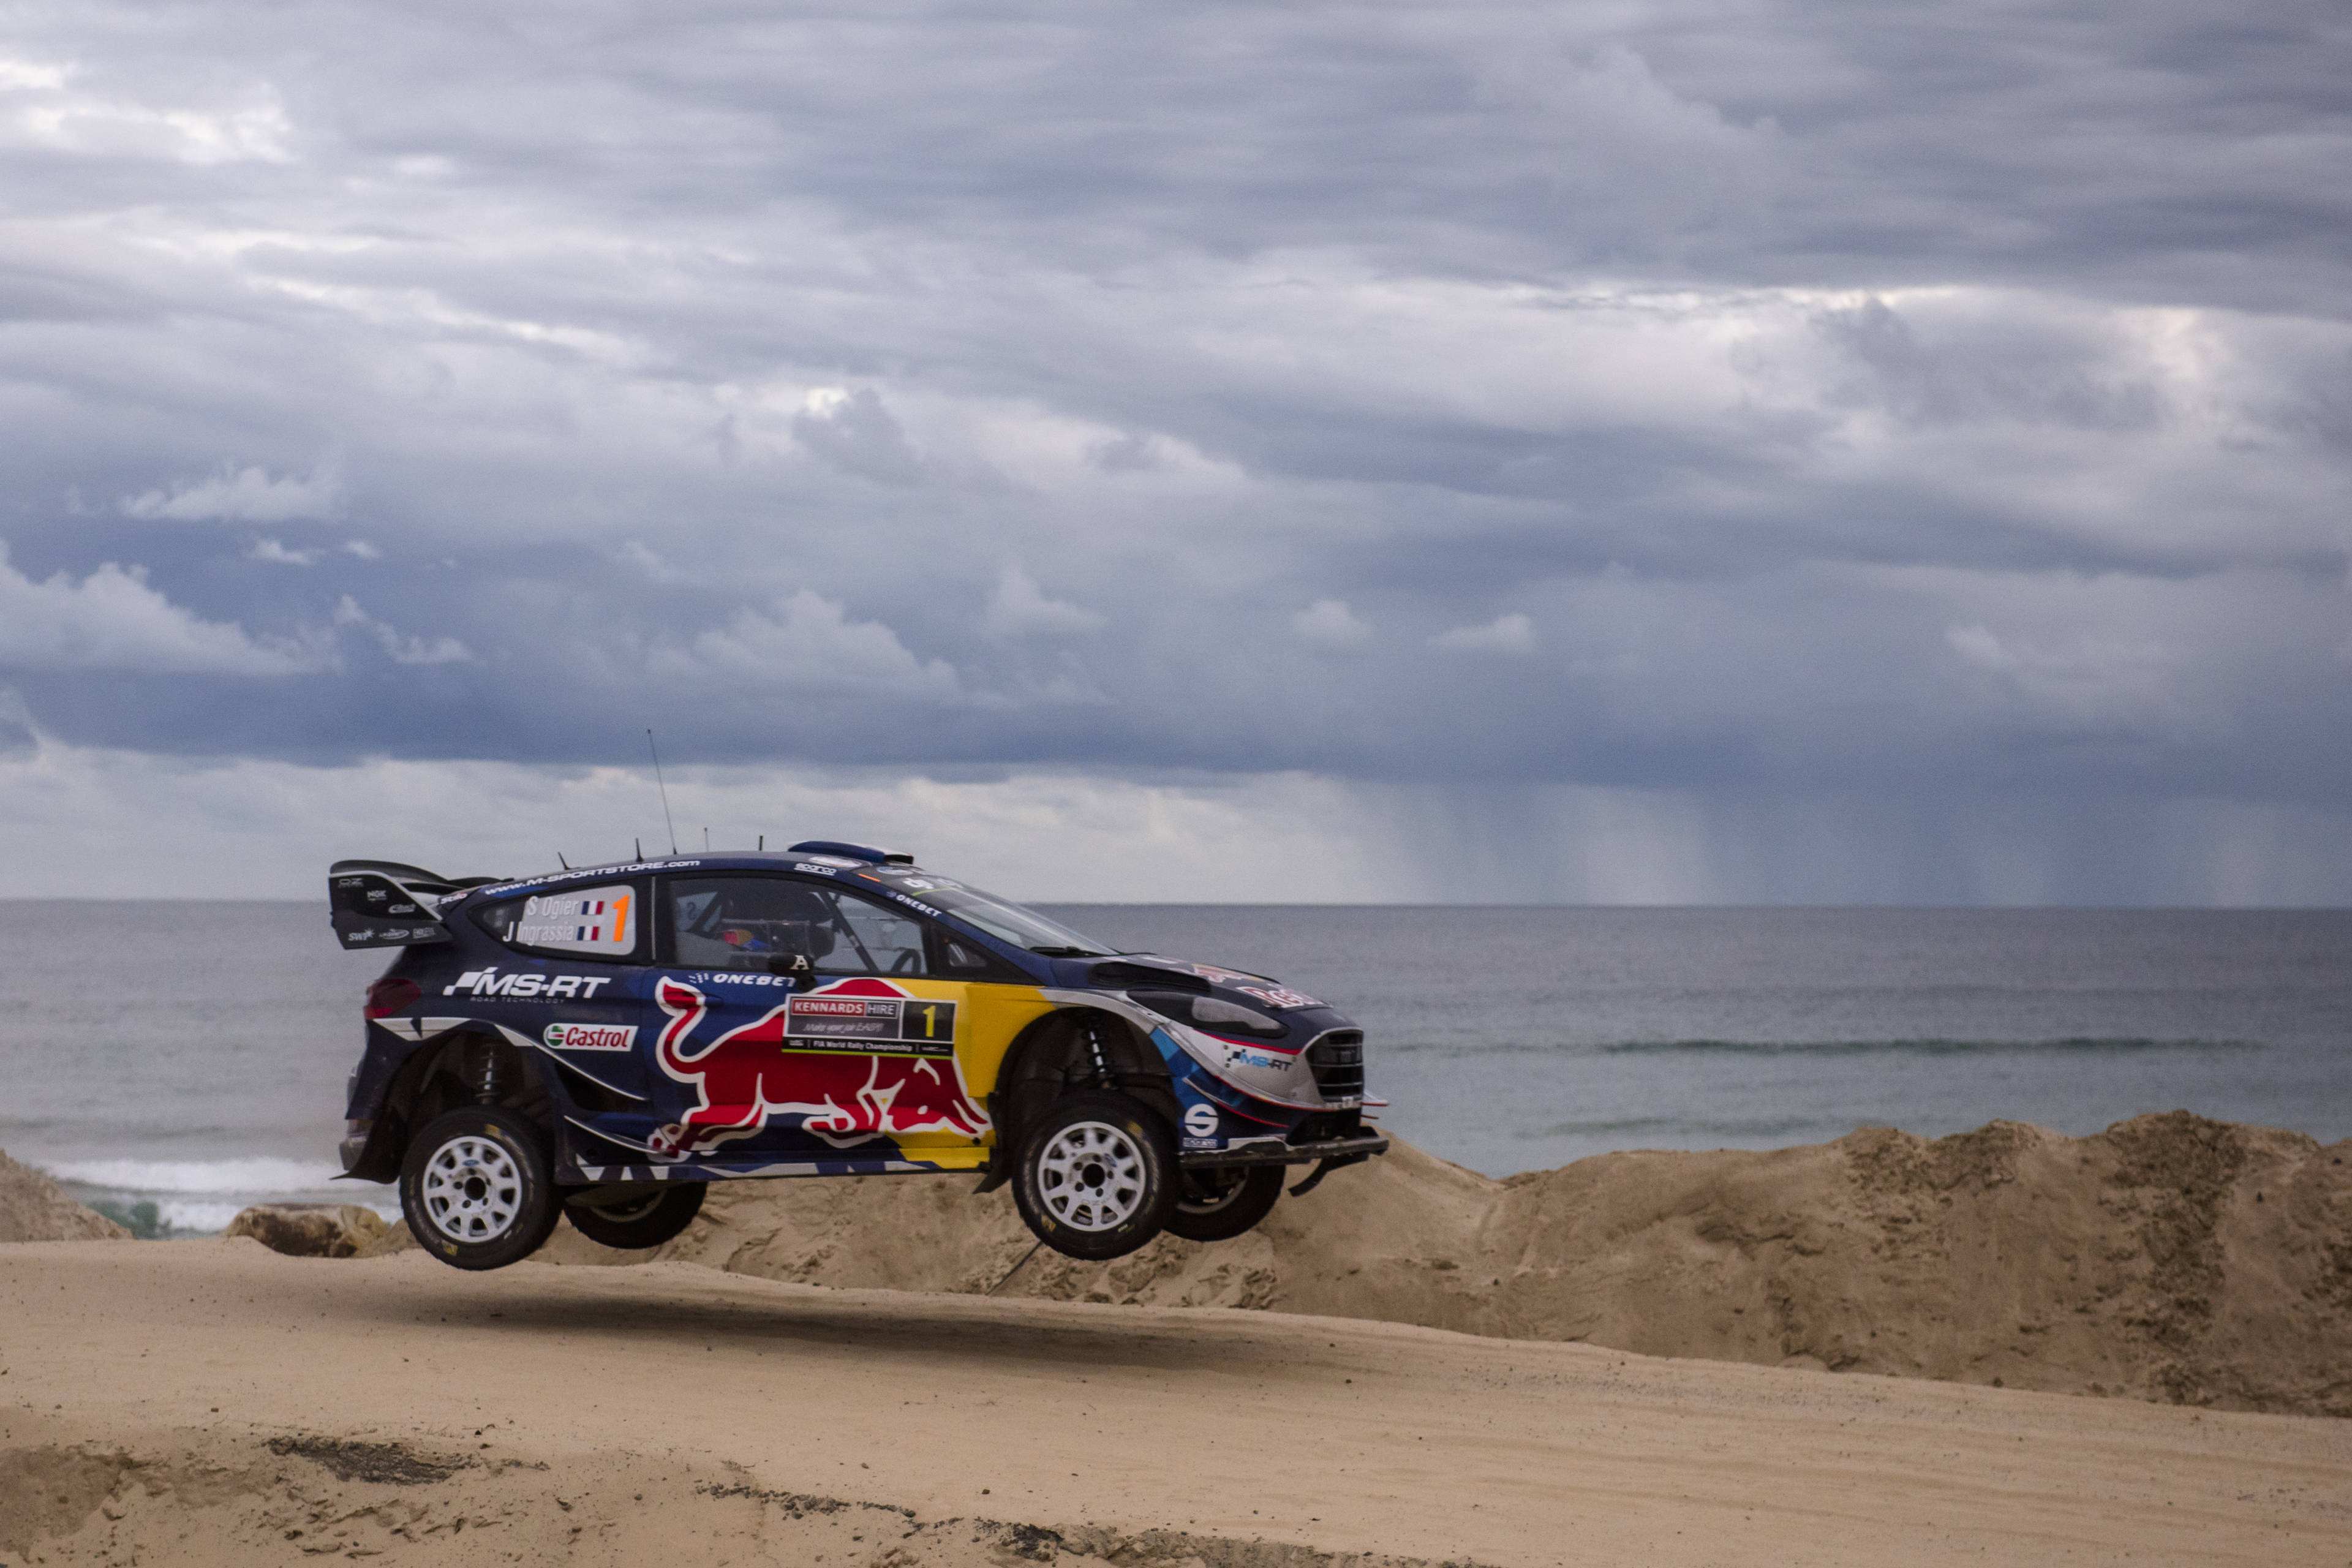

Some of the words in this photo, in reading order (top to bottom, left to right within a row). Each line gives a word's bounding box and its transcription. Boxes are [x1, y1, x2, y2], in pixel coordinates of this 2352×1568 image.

[484, 859, 700, 895] www.M-SPORTSTORE.com
[795, 862, 837, 875] sparco
[527, 895, 540, 916] S
[541, 896, 579, 920] Ogier
[896, 894, 942, 917] ONEBET
[612, 895, 630, 942] 1
[502, 921, 515, 942] J
[516, 921, 575, 946] Ingrassia
[794, 1001, 863, 1014] KENNARDS
[867, 1003, 895, 1016] HIRE
[922, 1005, 937, 1038] 1
[565, 1026, 630, 1048] Castrol
[847, 1042, 865, 1050] Rally
[865, 1042, 913, 1052] Championship
